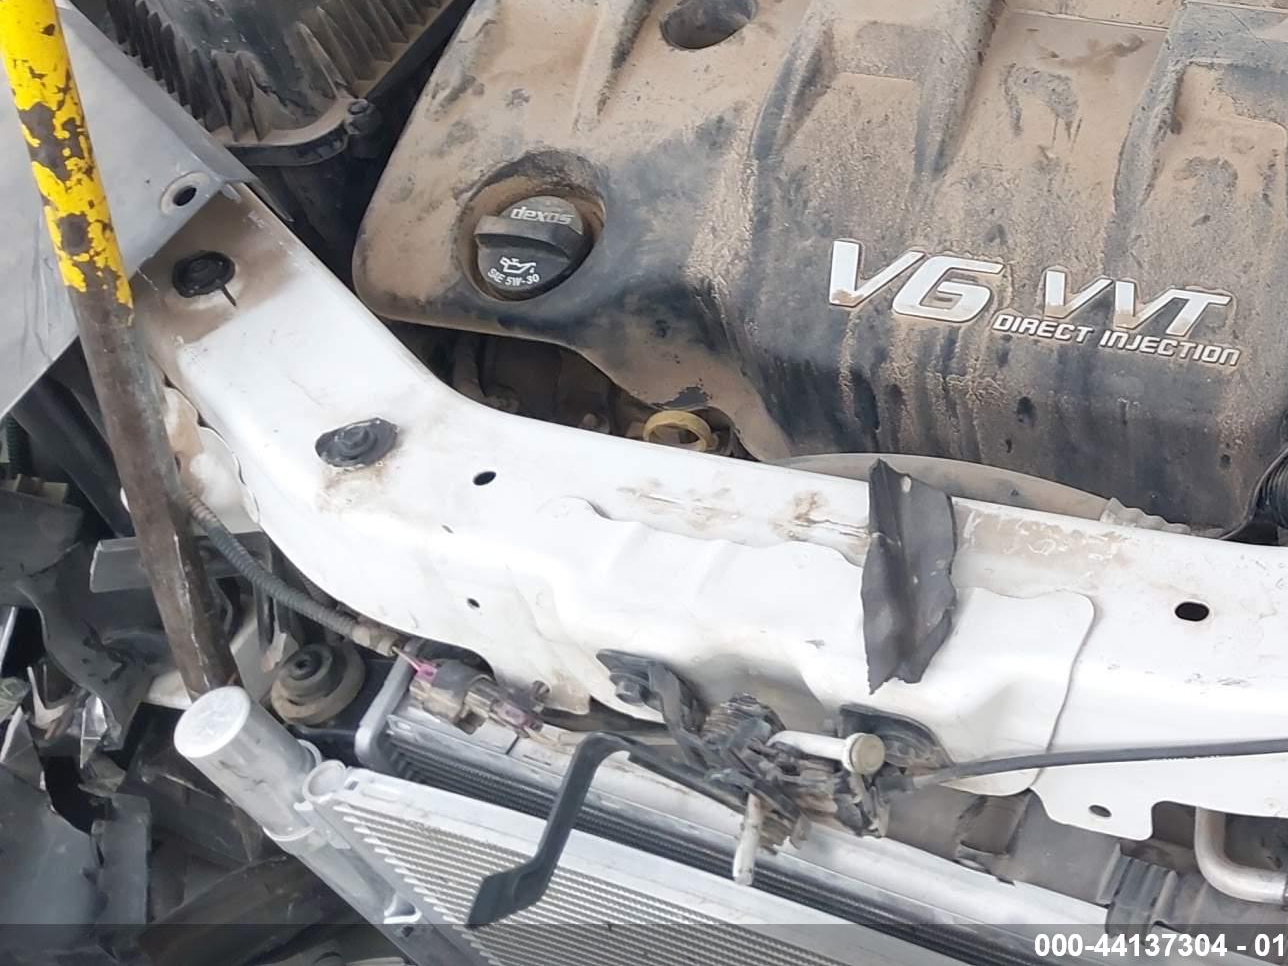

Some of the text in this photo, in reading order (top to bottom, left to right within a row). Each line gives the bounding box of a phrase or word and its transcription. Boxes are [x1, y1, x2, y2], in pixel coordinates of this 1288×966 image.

[510, 206, 575, 225] dexos
[487, 268, 540, 286] SAE 5W-30
[829, 238, 1232, 337] V6 VVT
[992, 313, 1241, 367] DIRECT INJECTION
